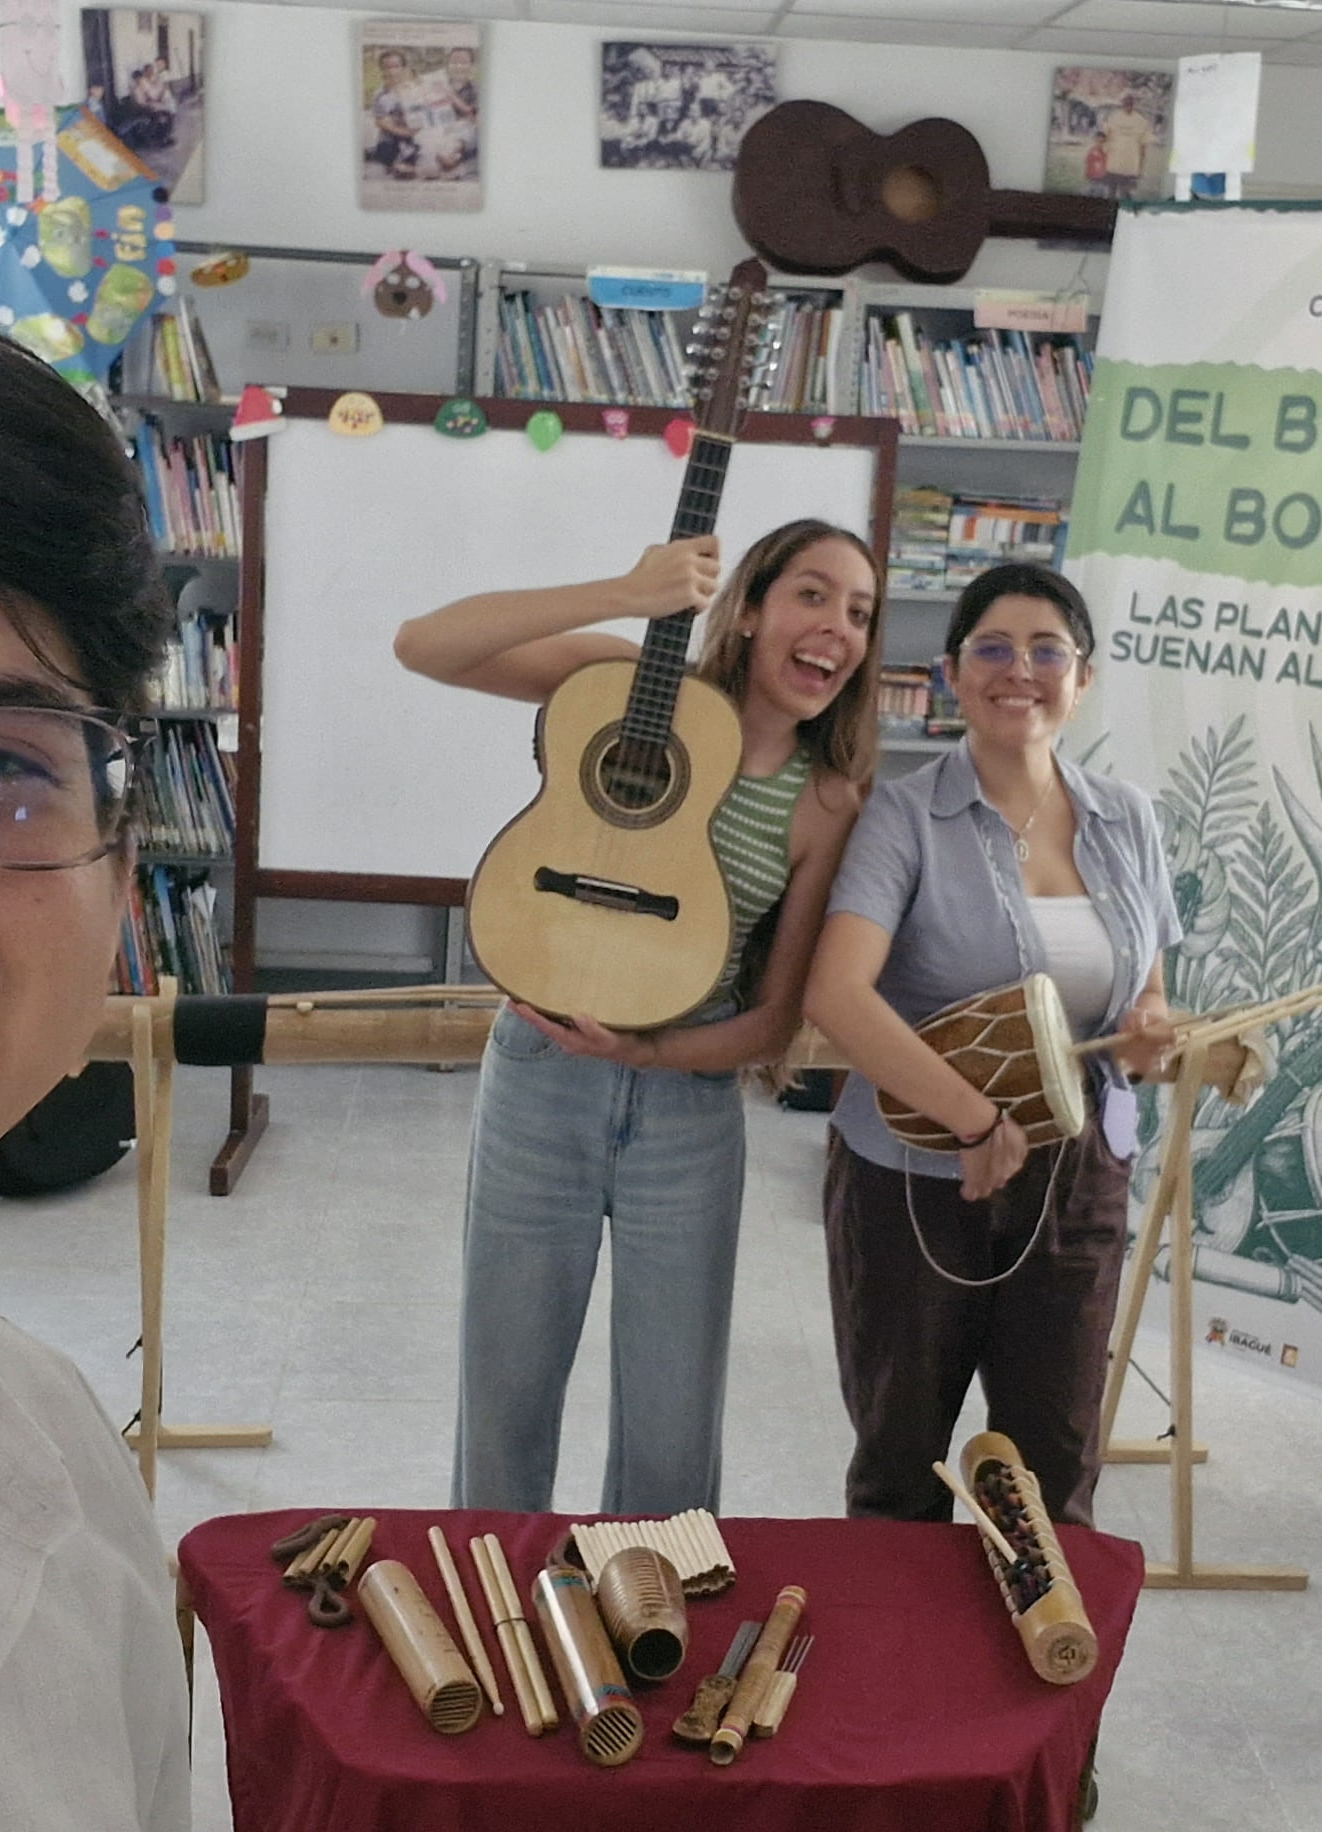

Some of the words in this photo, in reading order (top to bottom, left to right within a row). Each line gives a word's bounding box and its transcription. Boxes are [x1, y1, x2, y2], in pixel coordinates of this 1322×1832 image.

[1121, 387, 1250, 449] DEL
[1116, 480, 1199, 540] AL
[1130, 592, 1203, 628] LAS
[1110, 631, 1265, 680] SUENAN
